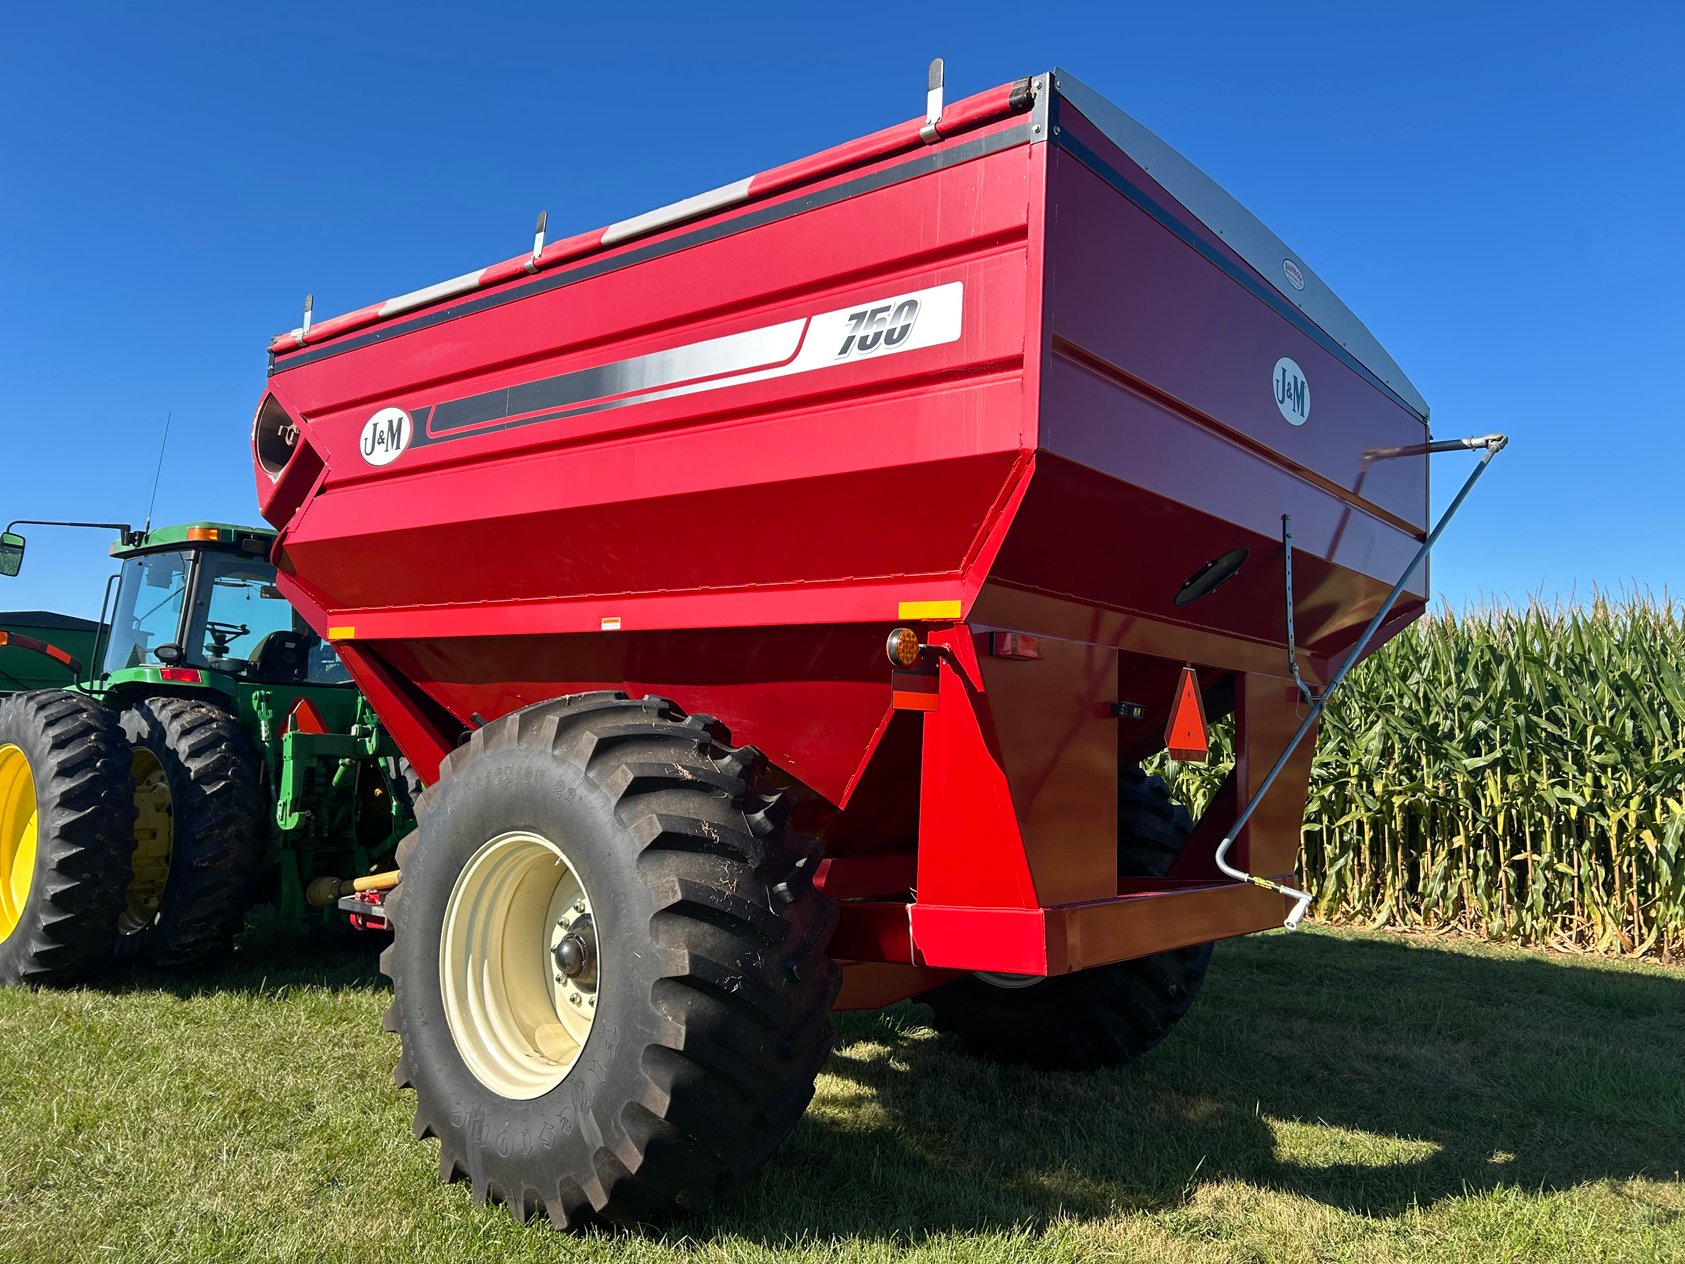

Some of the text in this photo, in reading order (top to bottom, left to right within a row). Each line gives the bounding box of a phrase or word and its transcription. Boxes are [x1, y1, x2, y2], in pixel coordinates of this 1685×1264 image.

[836, 298, 920, 357] 750
[1276, 366, 1306, 418] J&M
[364, 416, 404, 456] J&M
